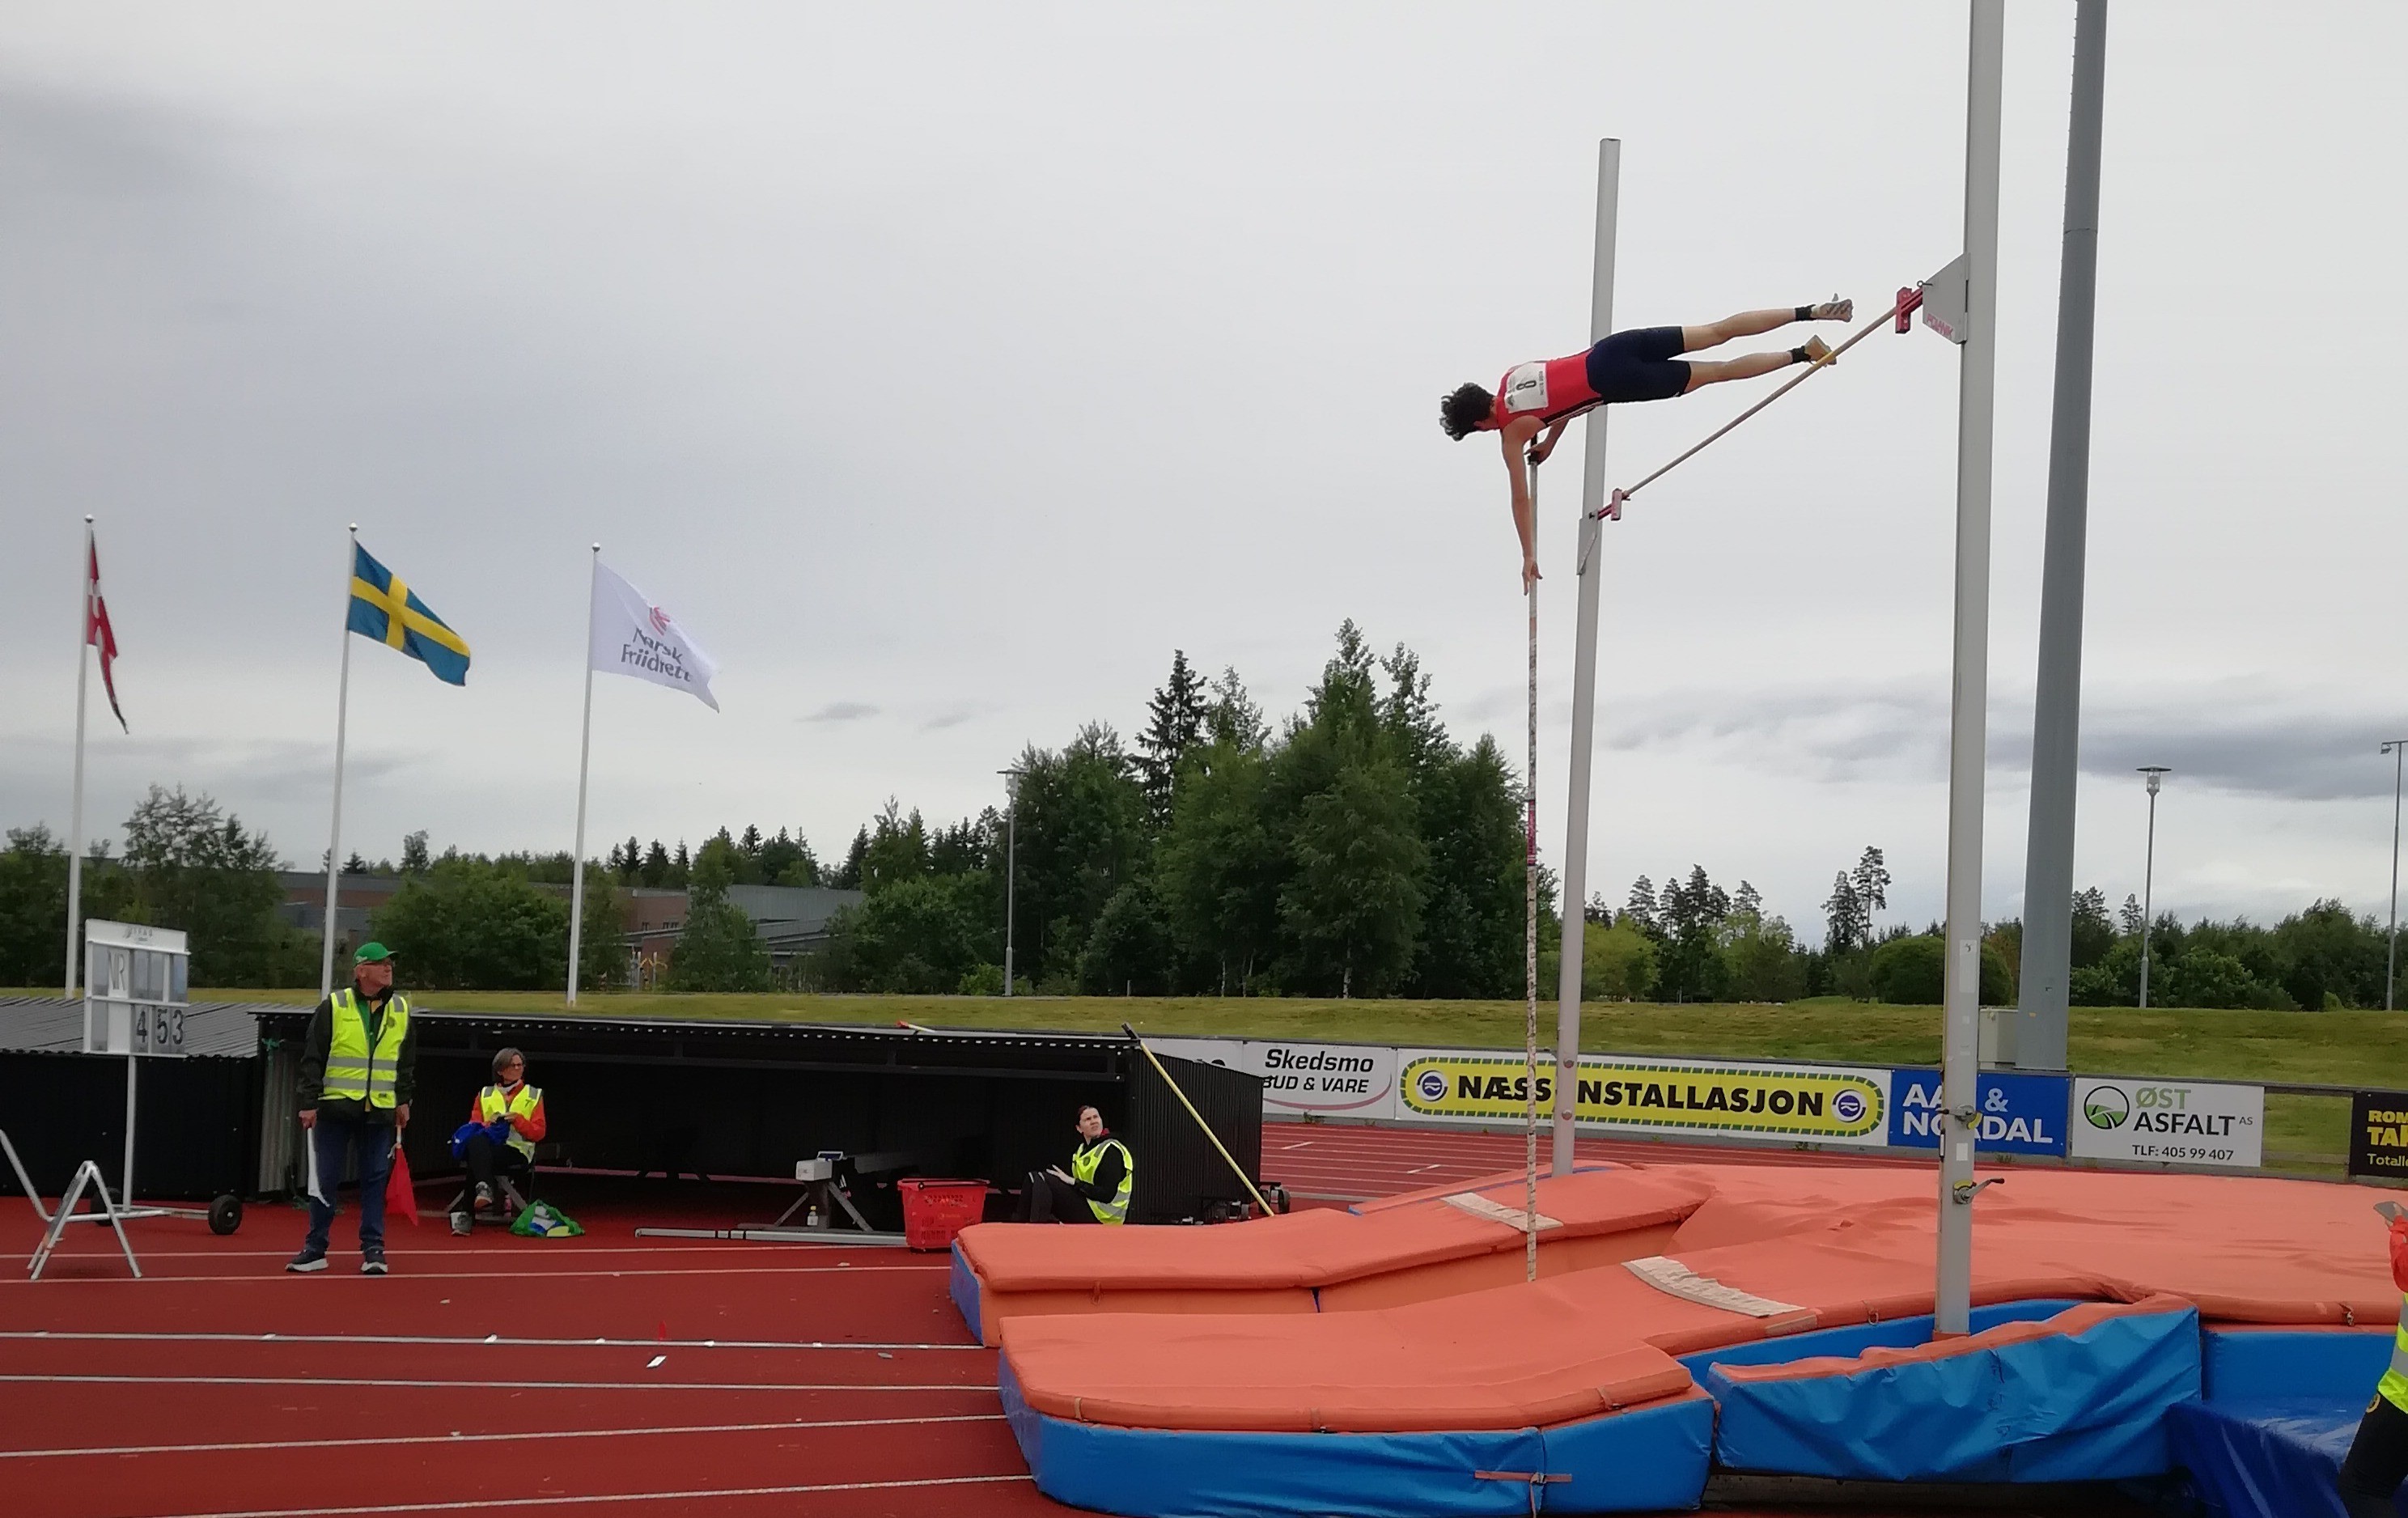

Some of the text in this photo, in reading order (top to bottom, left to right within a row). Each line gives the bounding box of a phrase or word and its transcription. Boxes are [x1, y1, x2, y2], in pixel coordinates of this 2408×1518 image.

[621, 644, 693, 682] Friidrett
[1265, 1049, 1374, 1072] Skedsmo
[1303, 1077, 1315, 1091] &
[1322, 1077, 1370, 1093] VARE
[1577, 1079, 1824, 1116] NSTALLASJON
[1984, 1088, 2008, 1113] &
[2135, 1087, 2192, 1110] ØST
[1903, 1111, 2054, 1143] NDAL
[2133, 1111, 2253, 1136] ASFALT AS
[2132, 1144, 2235, 1160] TLF: 405 99 407
